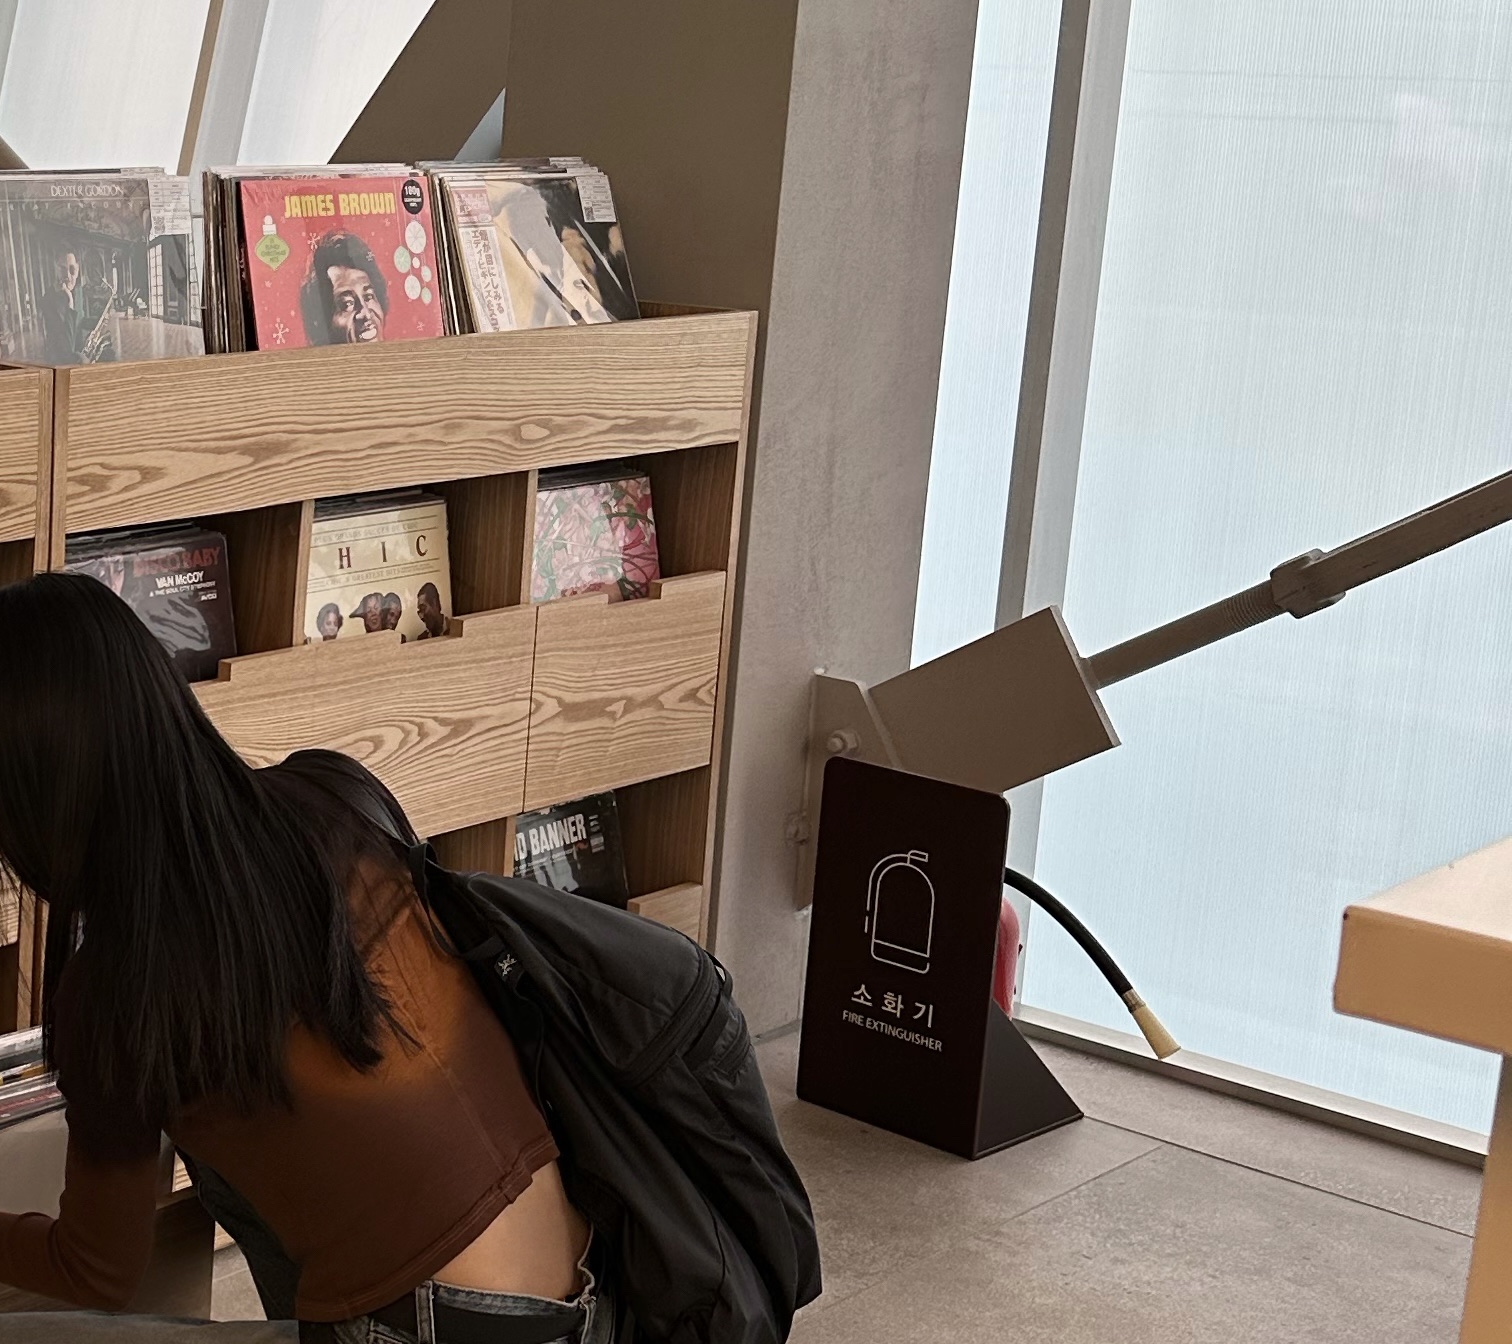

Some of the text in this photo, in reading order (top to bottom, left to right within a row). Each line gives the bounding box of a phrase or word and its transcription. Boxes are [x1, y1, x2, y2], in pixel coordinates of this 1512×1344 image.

[50, 184, 125, 198] DEXTER GORDON
[284, 192, 396, 219] JAMES BROWN
[182, 546, 221, 570] BABY
[155, 570, 205, 589] VAN McCOY
[528, 813, 587, 856] BANNER
[851, 983, 934, 1029] 소화기
[842, 1009, 943, 1053] FIRE EXTINGUISHER
